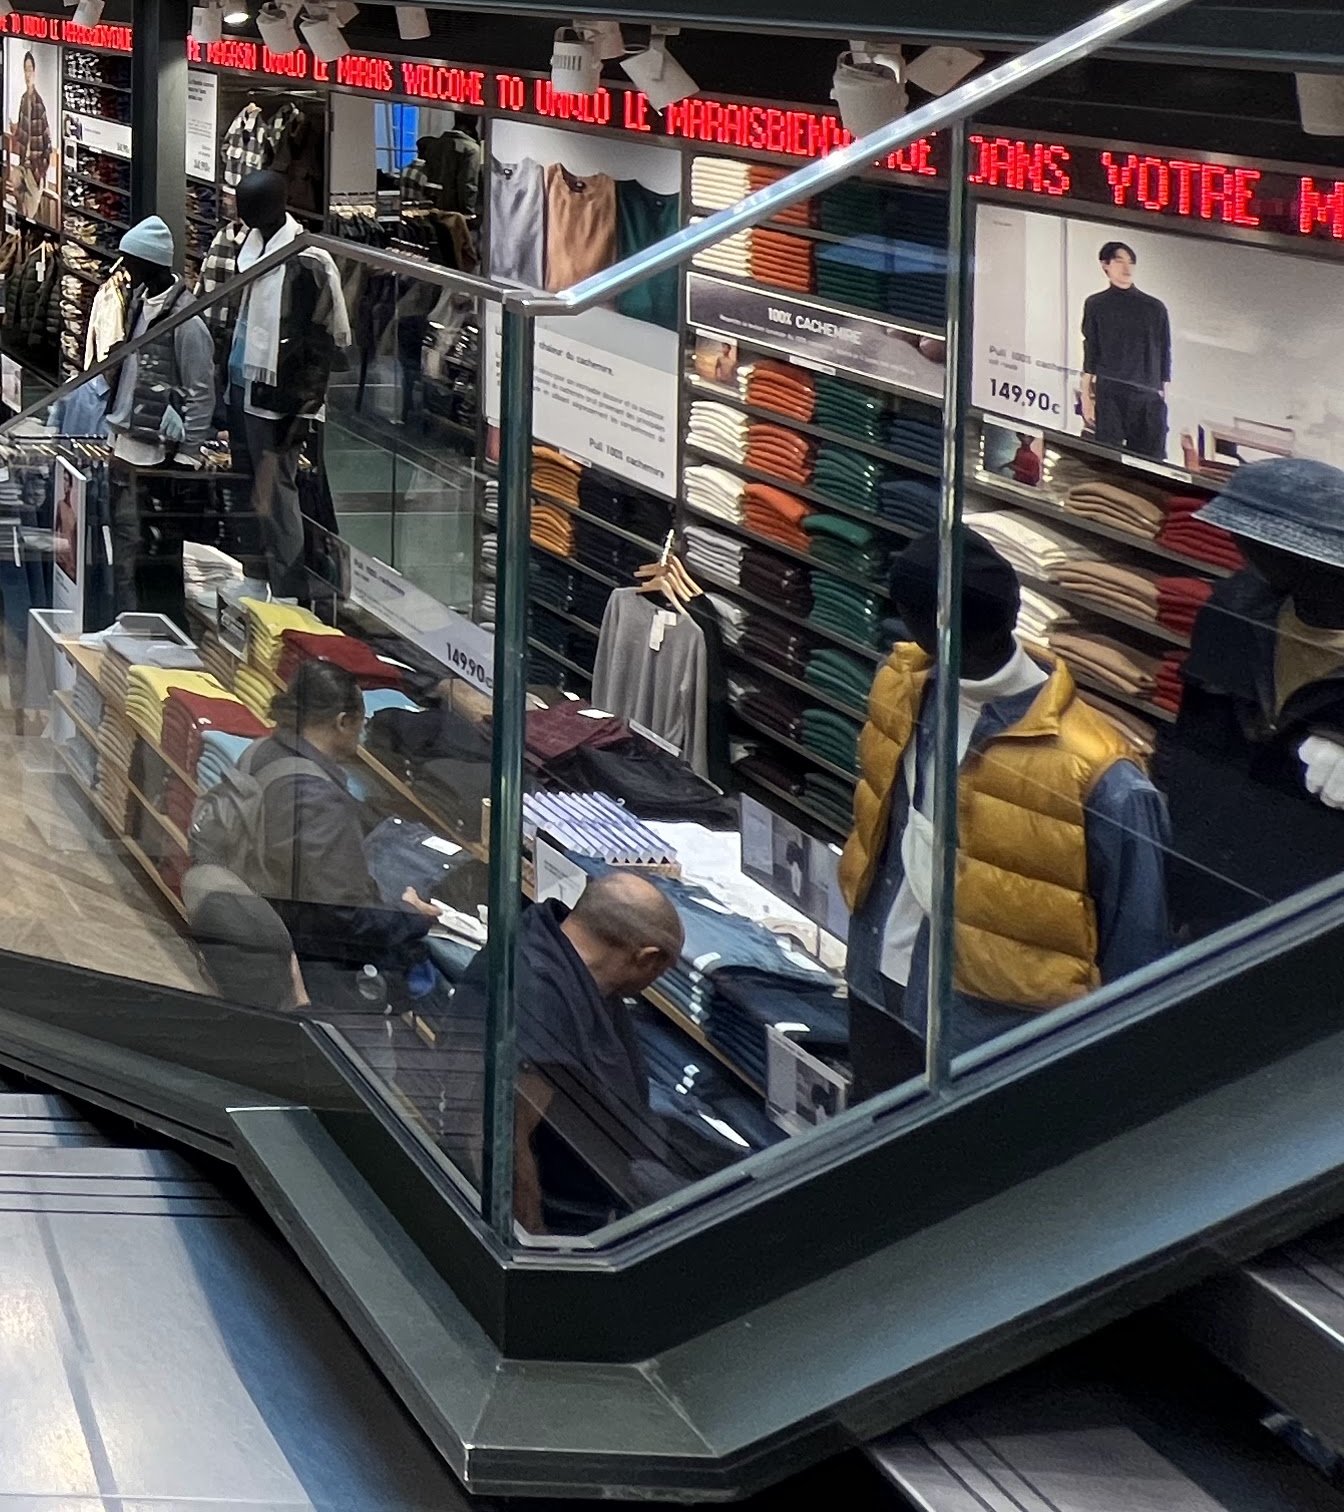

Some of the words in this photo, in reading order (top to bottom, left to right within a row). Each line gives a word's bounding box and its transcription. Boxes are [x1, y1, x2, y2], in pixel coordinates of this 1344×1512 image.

[336, 54, 393, 91] MARAIS
[401, 62, 484, 105] WELCOME
[495, 73, 524, 110] TO
[623, 90, 651, 132] LE
[1101, 152, 1261, 227] VOTRE
[768, 306, 792, 326] 100%
[795, 315, 863, 346] CACHEMIRE
[589, 436, 603, 452] Pull
